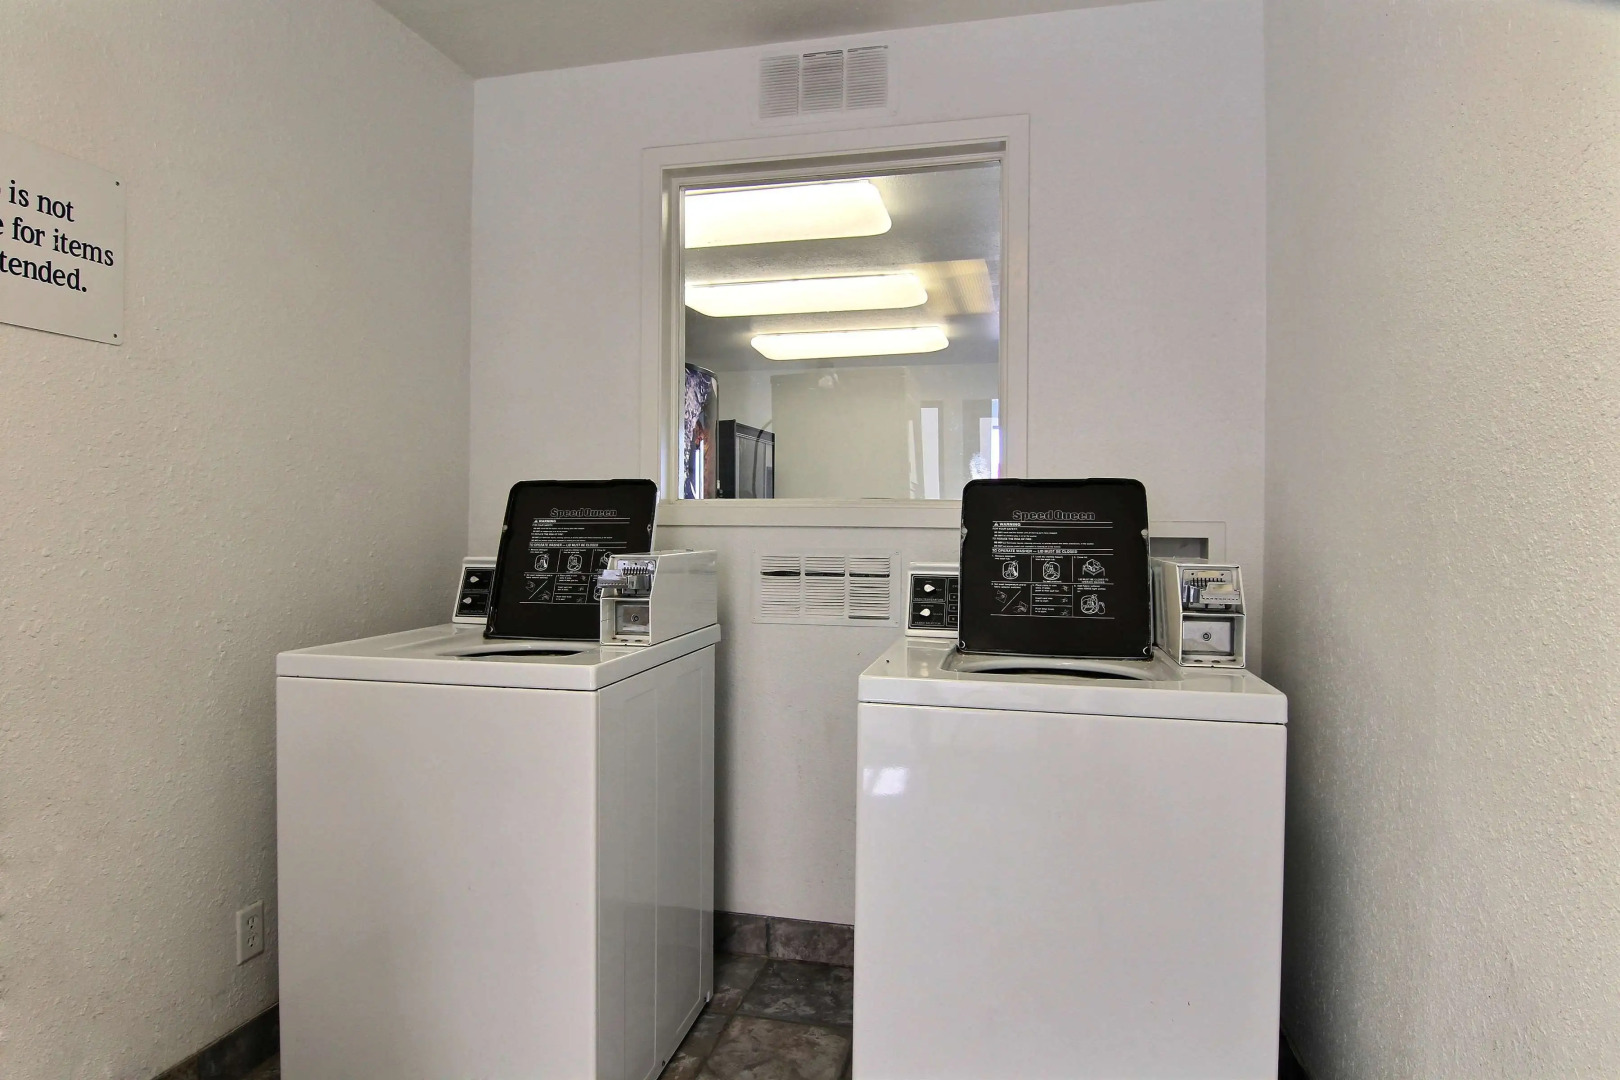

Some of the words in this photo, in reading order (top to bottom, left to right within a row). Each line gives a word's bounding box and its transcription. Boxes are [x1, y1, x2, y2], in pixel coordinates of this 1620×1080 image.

[9, 180, 29, 208] is
[37, 195, 75, 222] not
[12, 217, 46, 247] for
[53, 228, 114, 266] items
[0, 251, 87, 292] tended.
[550, 508, 584, 518] Speed
[1013, 510, 1053, 521] Speed
[1054, 510, 1096, 520] Queen
